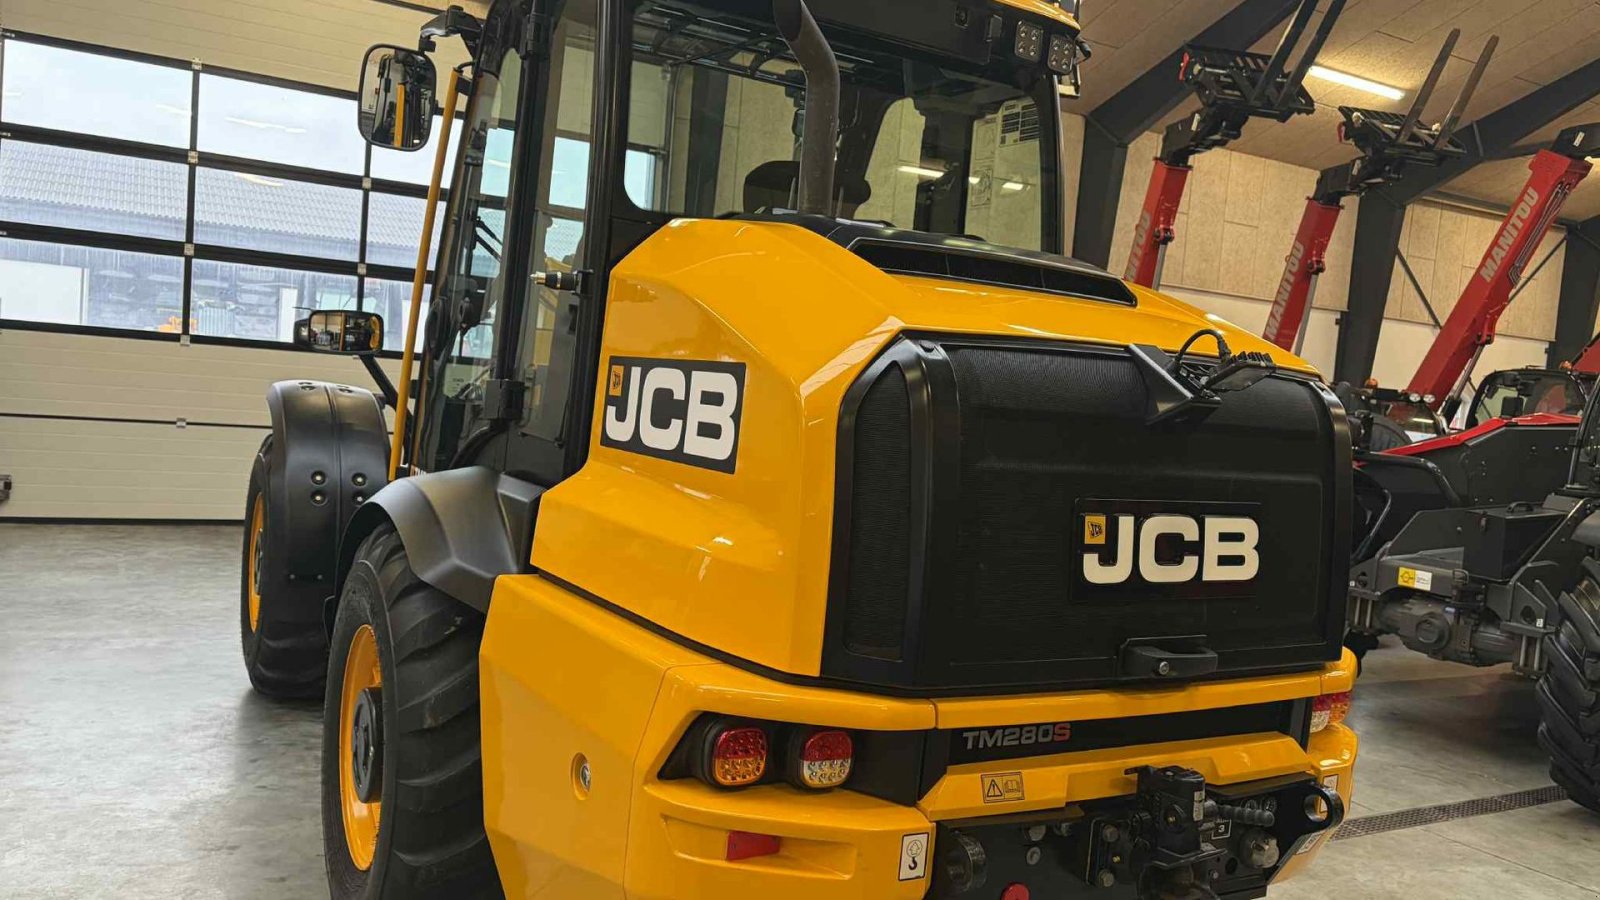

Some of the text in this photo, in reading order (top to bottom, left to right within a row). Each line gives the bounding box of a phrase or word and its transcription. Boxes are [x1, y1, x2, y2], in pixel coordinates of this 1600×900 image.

[1124, 208, 1152, 282] NITOU
[1480, 186, 1539, 283] MANITOU
[1264, 241, 1304, 340] MANITOU
[605, 366, 738, 461] JCB
[1083, 514, 1260, 584] JCB
[962, 723, 1071, 750] TM280S
